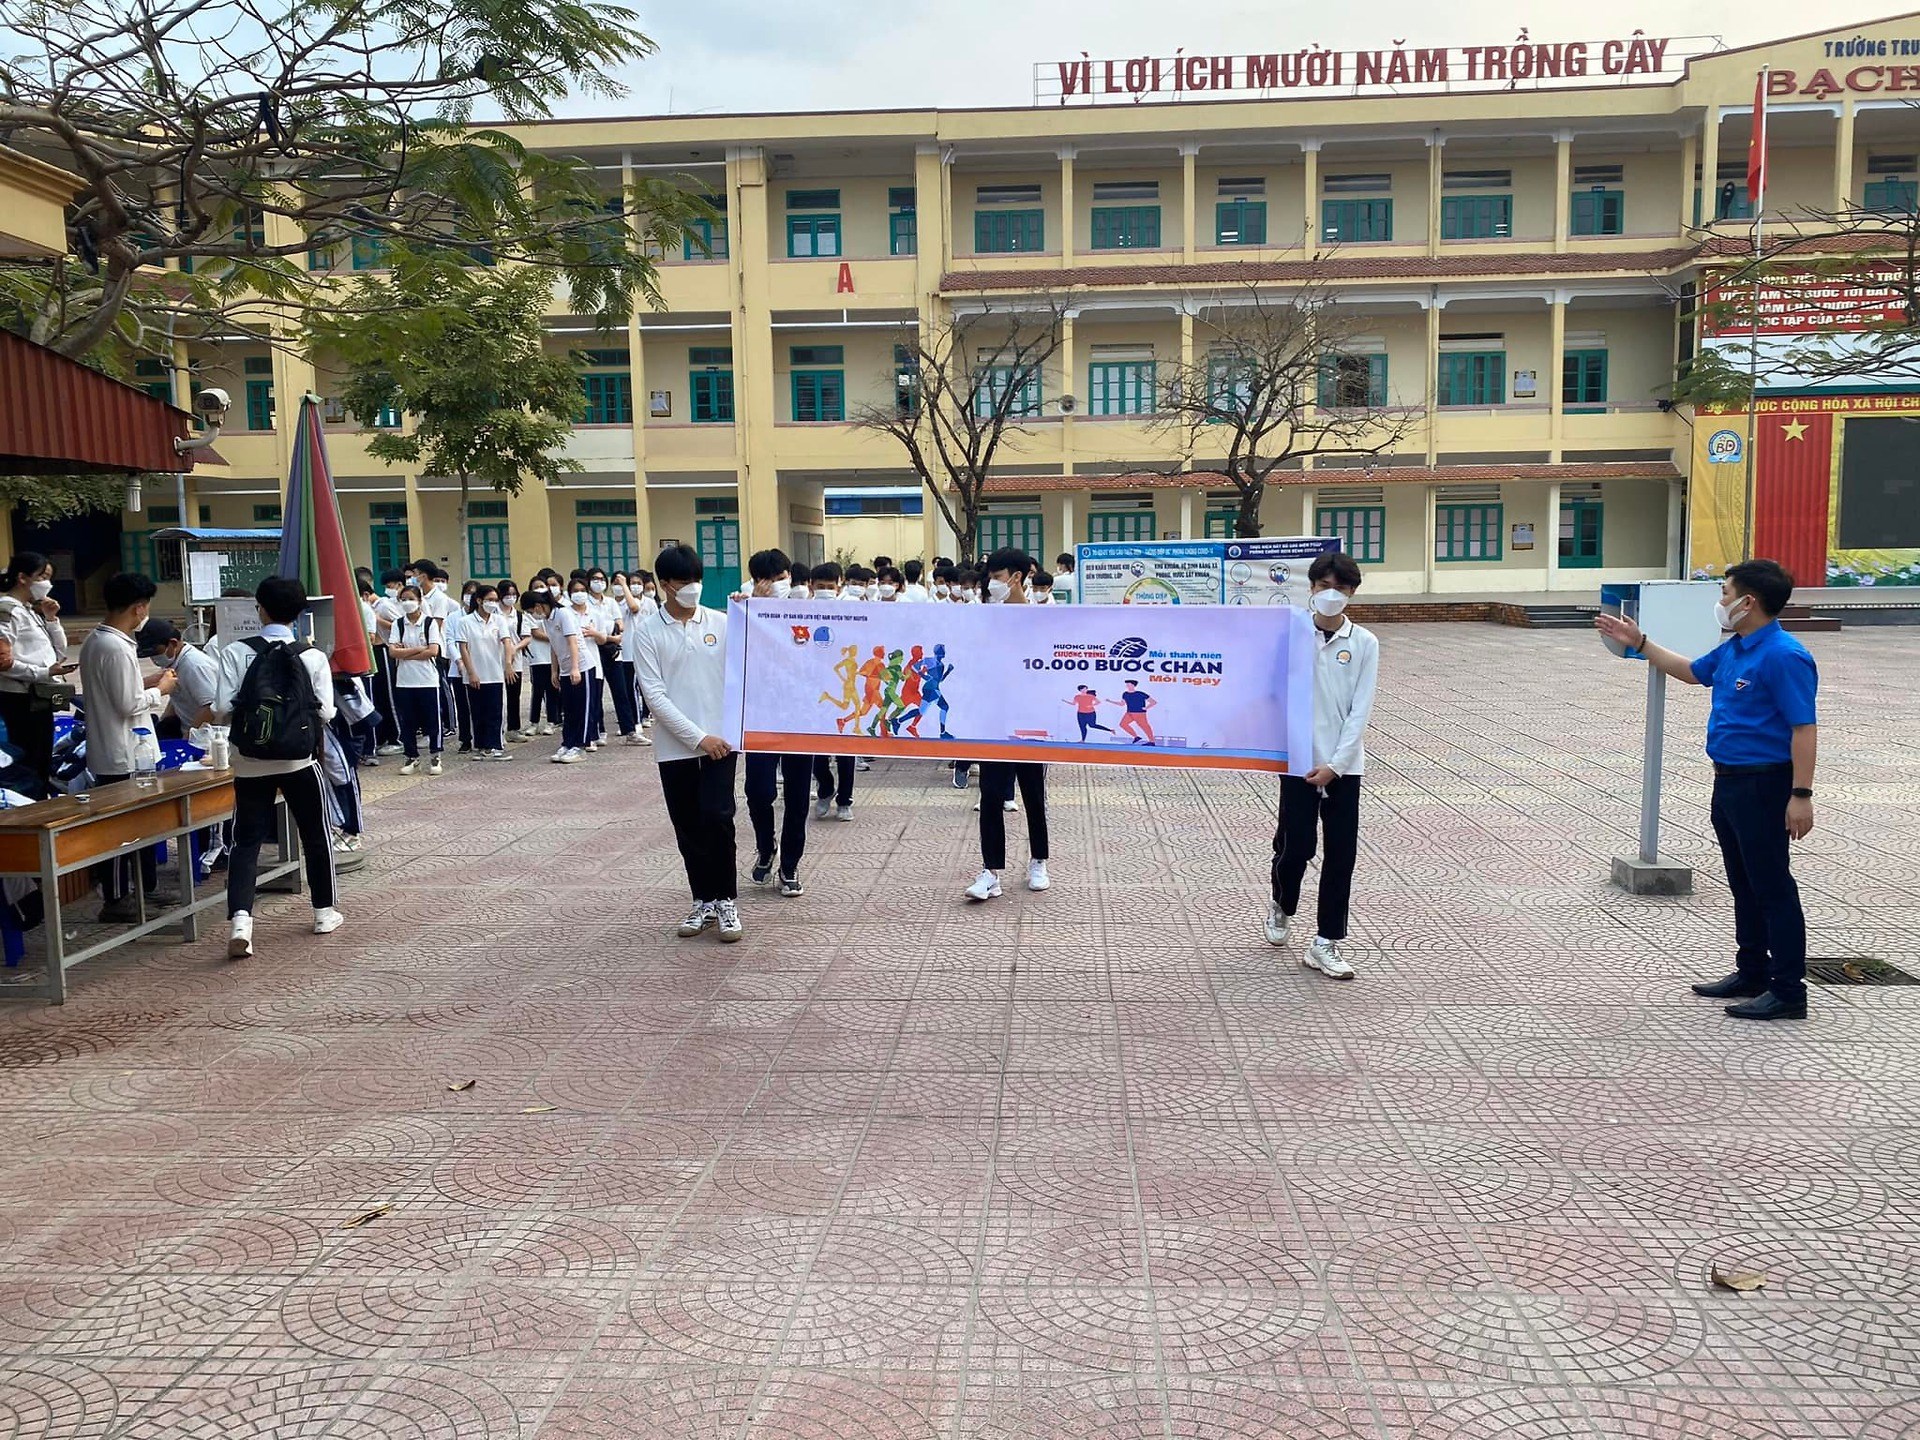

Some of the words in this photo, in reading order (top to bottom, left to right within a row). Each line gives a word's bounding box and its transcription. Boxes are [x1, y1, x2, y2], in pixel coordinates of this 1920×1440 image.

[1824, 35, 1887, 58] TRƯỜNG
[1059, 52, 1090, 94] VÌ
[1105, 56, 1160, 104] LỢI
[1175, 47, 1232, 91] ÍCH
[1246, 43, 1342, 88] MƯỜI
[1356, 38, 1448, 85] NĂM
[1462, 26, 1587, 80] TRỒNG
[1602, 29, 1669, 75] CÂY
[1757, 65, 1920, 100] BẠCH
[837, 263, 855, 293] A
[1782, 316, 1806, 328] TẬP
[1809, 314, 1835, 328] CỦA
[1782, 398, 1818, 413] CỘNG
[1822, 396, 1850, 410] HÒA
[1875, 395, 1898, 410] HỘI
[1022, 658, 1089, 672] 10.000
[1170, 651, 1198, 659] thanh
